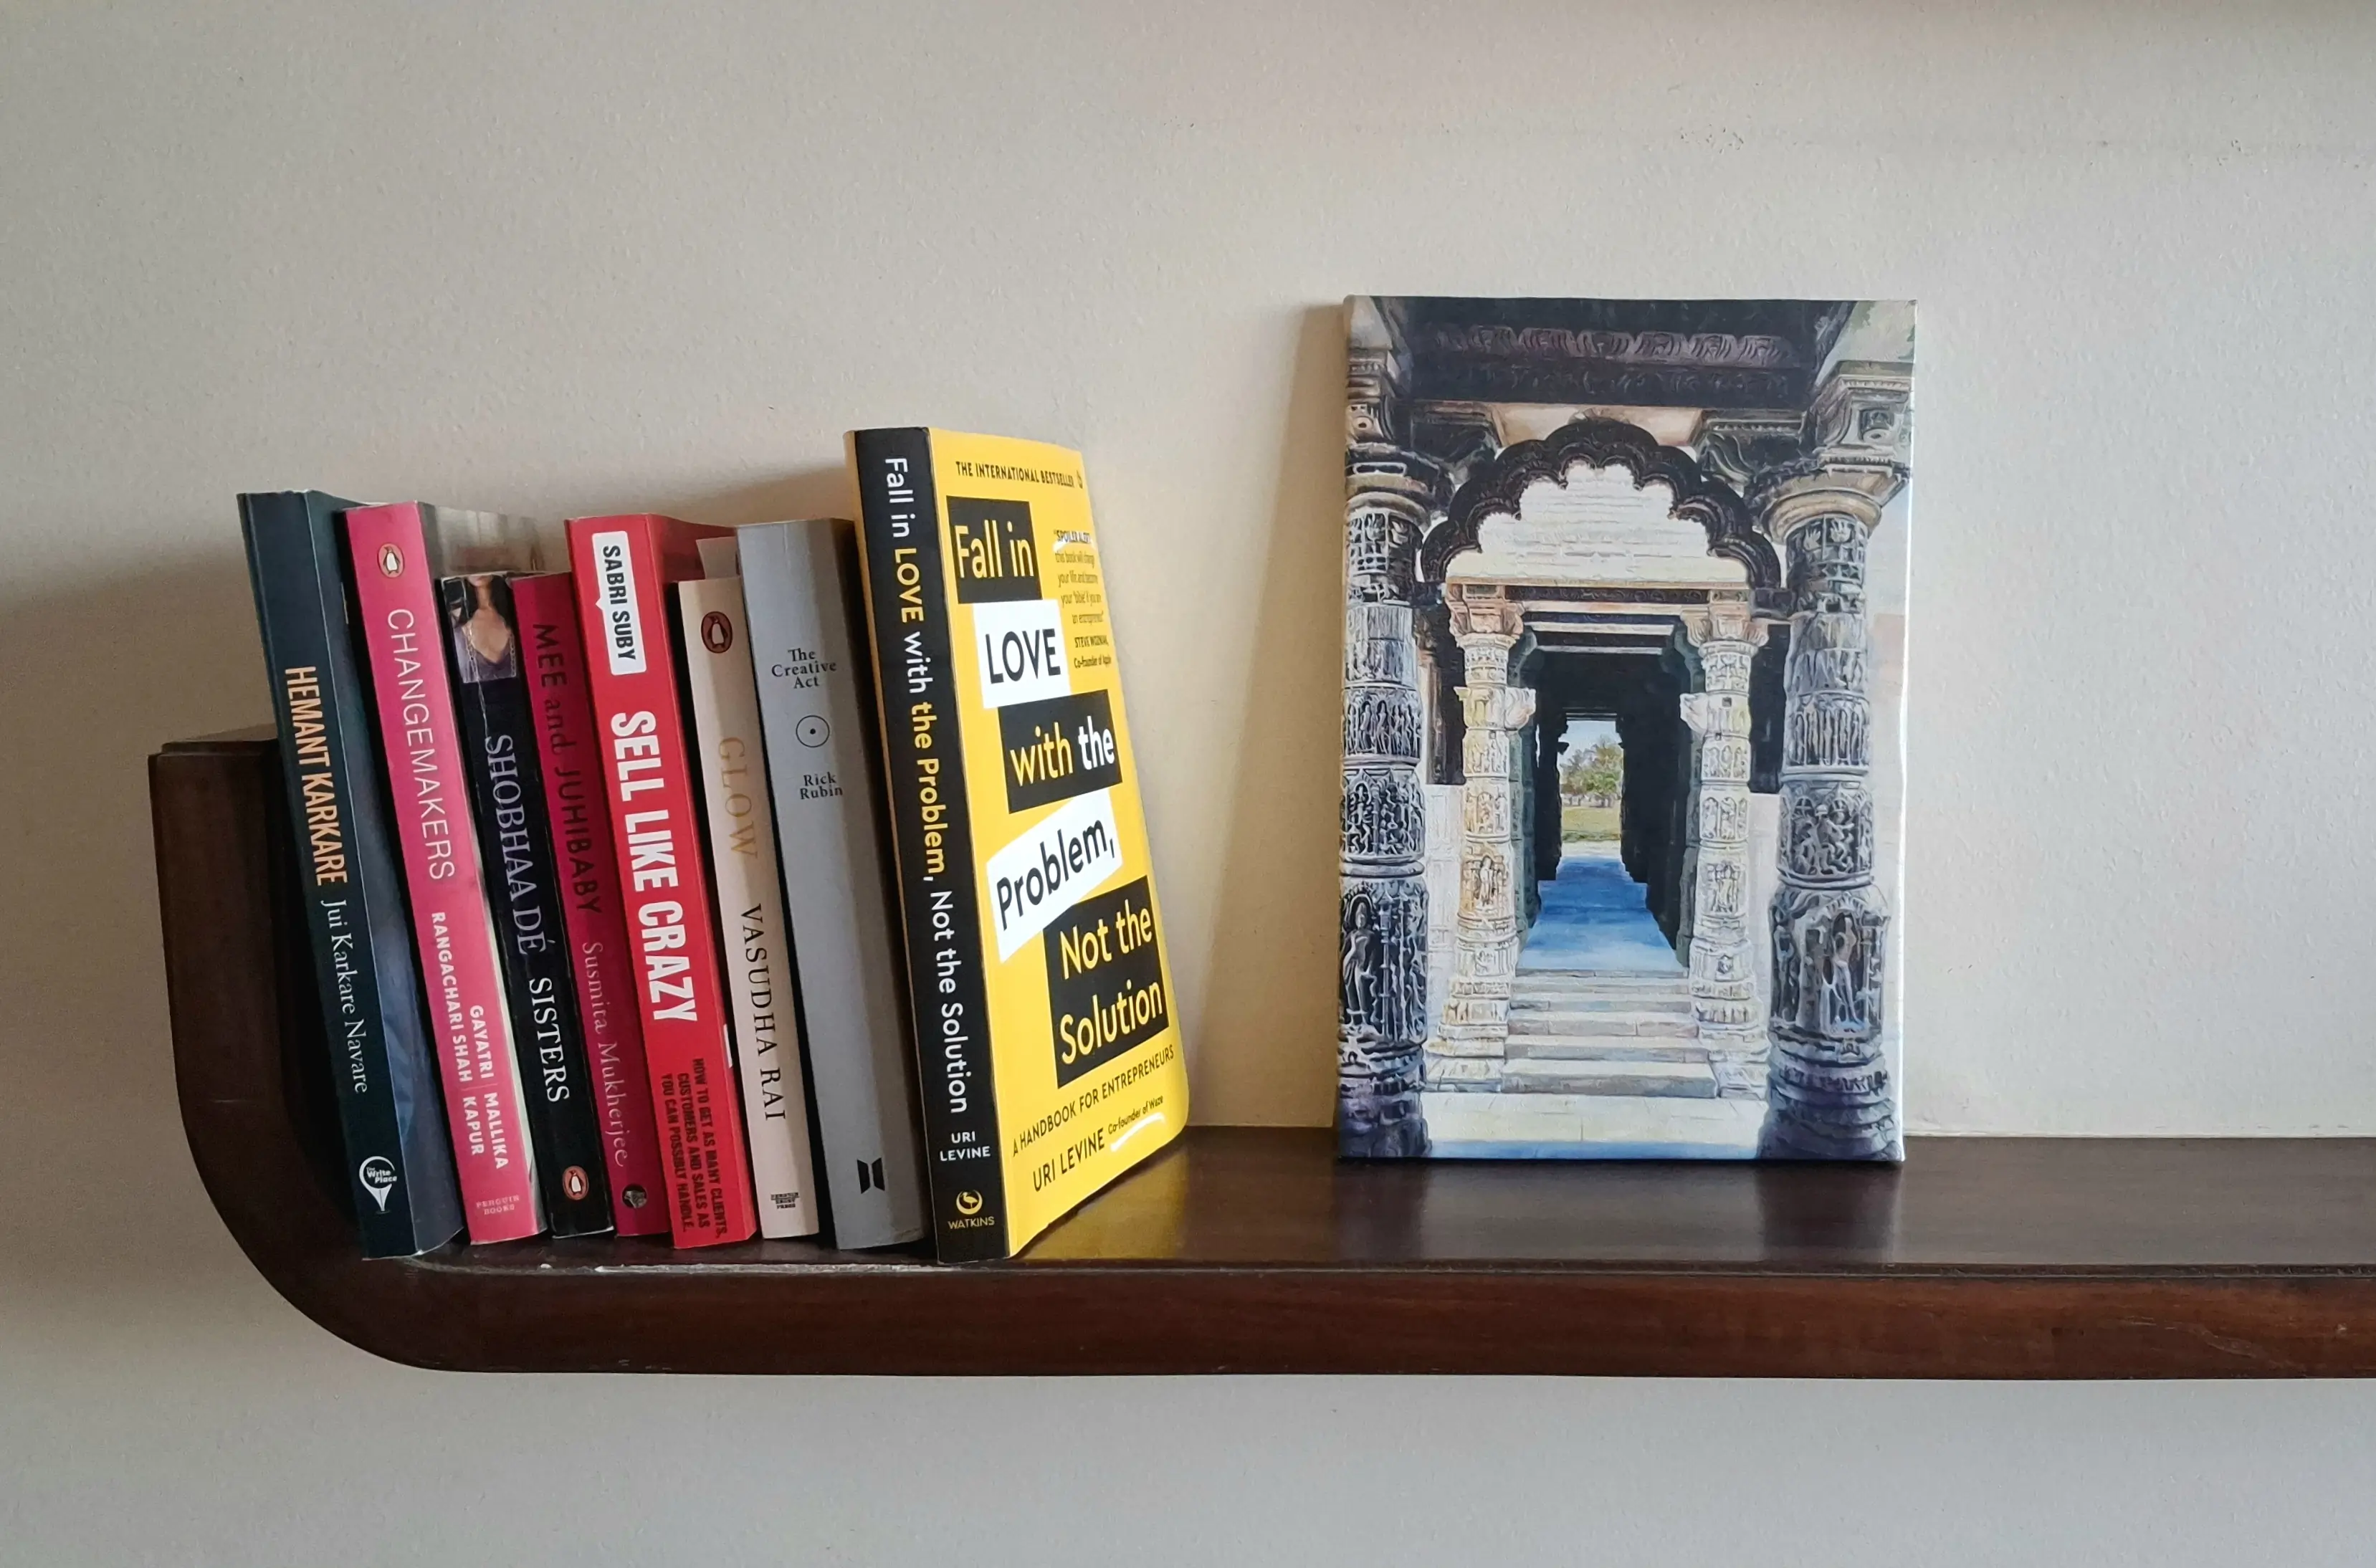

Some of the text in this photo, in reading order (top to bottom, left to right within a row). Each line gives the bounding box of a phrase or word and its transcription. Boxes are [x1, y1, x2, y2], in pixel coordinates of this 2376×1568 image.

[955, 461, 973, 477] THE
[975, 463, 1040, 483] INTERNATIONAL
[953, 520, 1034, 579] Fall in
[602, 545, 636, 661] SABRI SUBY
[771, 661, 836, 678] Creative
[788, 649, 816, 661] The
[793, 677, 820, 689] Act
[985, 628, 1061, 684] LOVE
[387, 608, 455, 880] CHANGEMAKERS
[533, 623, 602, 914] MEE and JUHIBABY
[1010, 715, 1115, 787] with the
[285, 666, 347, 886] HEMANT KARKARE
[719, 737, 758, 859] GLOW
[800, 785, 844, 799] Rubin
[803, 772, 836, 785] Rick
[884, 457, 972, 1114] Fall in LOVE with the Problem, Not the Solution
[485, 735, 556, 955] SHOBHAA DÉ
[611, 710, 698, 1022] SELL LIKE CRAZY
[996, 819, 1115, 932] Problem,
[1060, 899, 1153, 980] Not the
[321, 899, 368, 1094] Jui Karkare Navare
[431, 911, 473, 1083] RANGACHARI SHAH
[740, 903, 786, 1122] VASUDHA RAI
[1060, 979, 1163, 1064] Solution
[469, 1005, 495, 1079] GAYATRI
[529, 977, 570, 1103] SISTERS
[582, 942, 631, 1167] Susmita Mukherjee
[662, 1073, 674, 1096] YOU
[693, 1058, 706, 1085] HOW
[697, 1088, 710, 1103] TO
[1013, 1044, 1174, 1157] A HANDBOOK FOR ENTREPRENEURS
[463, 1096, 485, 1157] KAPUR
[484, 1092, 509, 1170] MALLIKA
[665, 1098, 679, 1124] CAN
[699, 1106, 712, 1127] GET
[703, 1131, 715, 1147] AS
[951, 1131, 975, 1144] URI
[1108, 1108, 1141, 1134] Co-founder
[1142, 1101, 1149, 1114] of
[367, 1170, 391, 1179] Write
[375, 1175, 397, 1184] Place
[669, 1127, 687, 1180] POSSIBLY
[677, 1073, 710, 1229] CUSTOMERS AND SALES AS
[940, 1146, 991, 1162] LEVINE
[1033, 1128, 1105, 1192] URI LEVINE
[476, 1195, 520, 1208] PENGUIN
[484, 1204, 515, 1215] BOOKS
[948, 1216, 995, 1229] WATKINS
